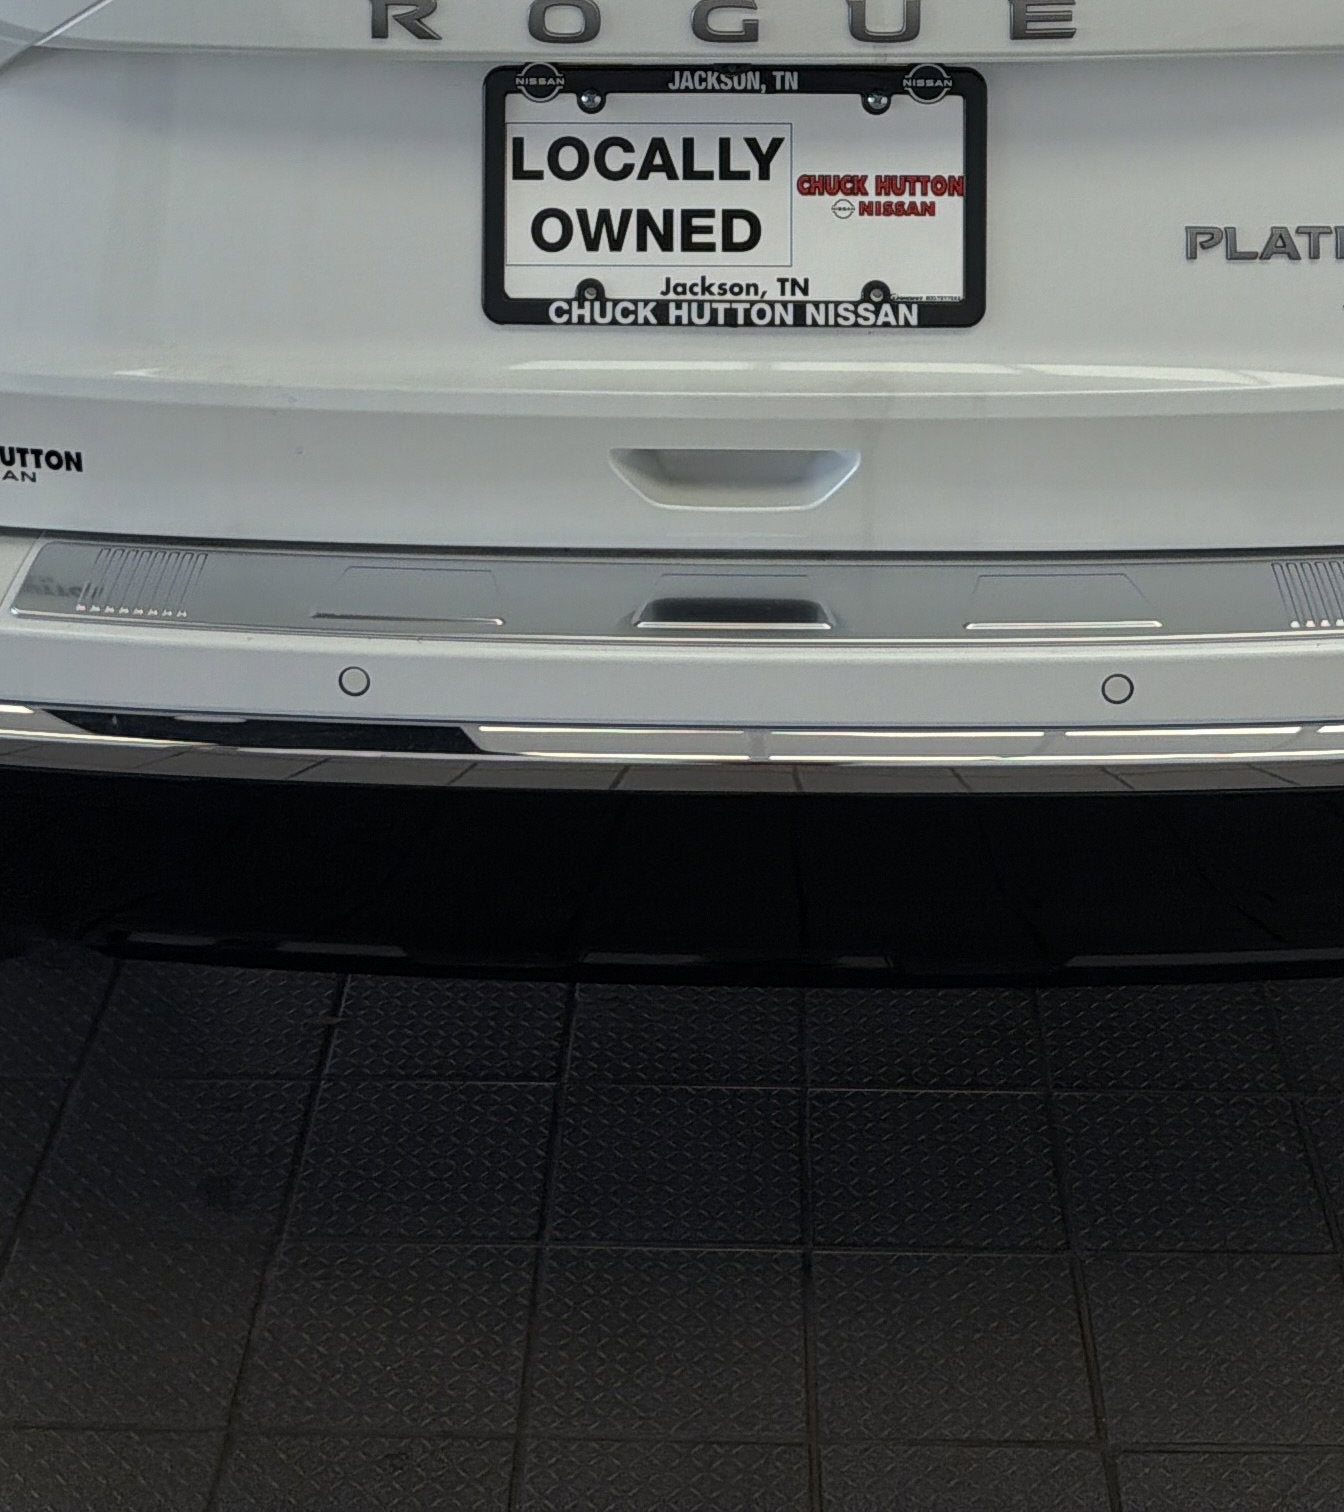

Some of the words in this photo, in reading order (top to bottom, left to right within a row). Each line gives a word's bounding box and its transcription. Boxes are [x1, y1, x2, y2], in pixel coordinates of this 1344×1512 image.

[515, 77, 565, 86] NISSAN
[668, 70, 767, 93] JACKSON,
[774, 70, 799, 90] TN
[903, 79, 953, 88] NISSAN
[511, 137, 785, 181] LOCALLY
[797, 174, 869, 197] CHUCK
[875, 174, 965, 197] HUTTON
[858, 201, 936, 217] NISSAN
[530, 207, 762, 253] OWNED
[660, 276, 767, 299] Jackson,
[776, 277, 809, 297] TN
[548, 301, 657, 325] CHUCK
[668, 301, 794, 326] HUTTON
[804, 301, 919, 326] NISSAN
